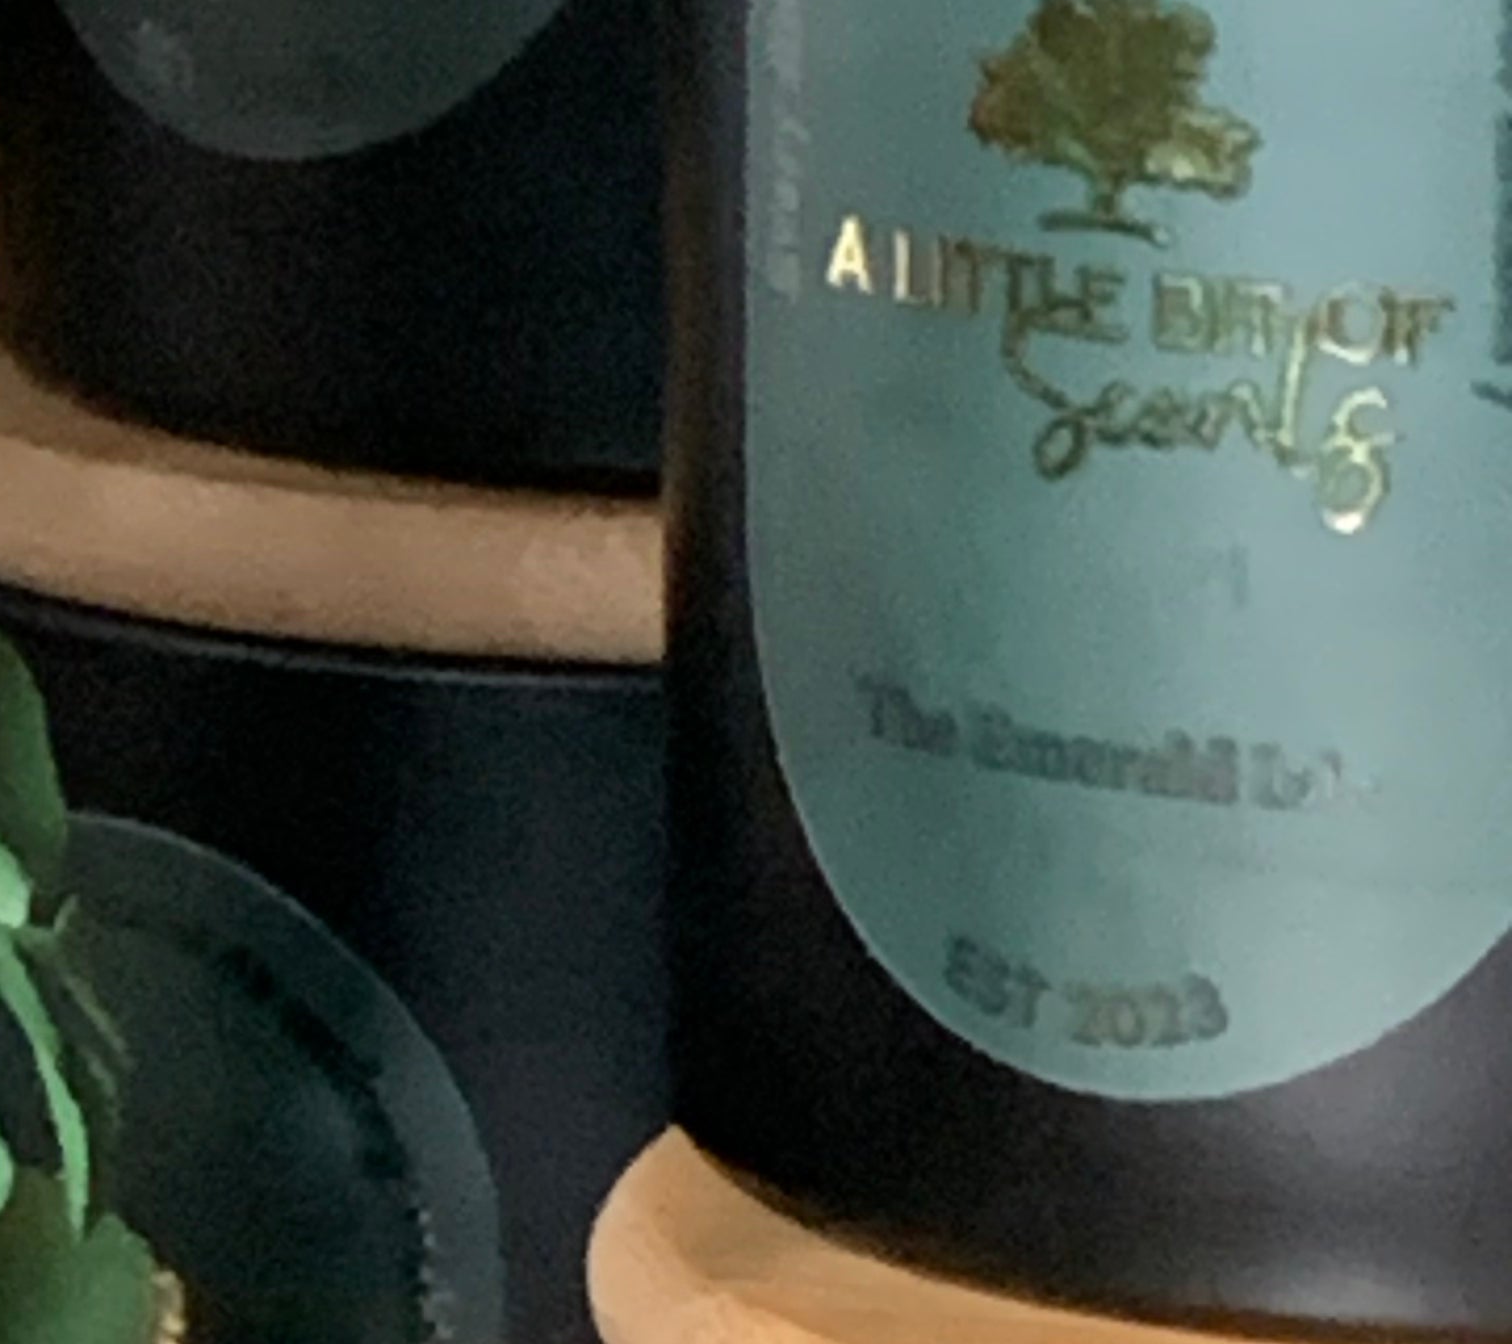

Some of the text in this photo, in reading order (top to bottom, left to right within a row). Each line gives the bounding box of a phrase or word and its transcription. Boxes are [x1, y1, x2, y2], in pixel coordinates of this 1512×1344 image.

[826, 214, 873, 296] A
[892, 228, 1128, 344] LITTLE
[848, 666, 959, 758] The
[943, 931, 1229, 1049] EST 2023
